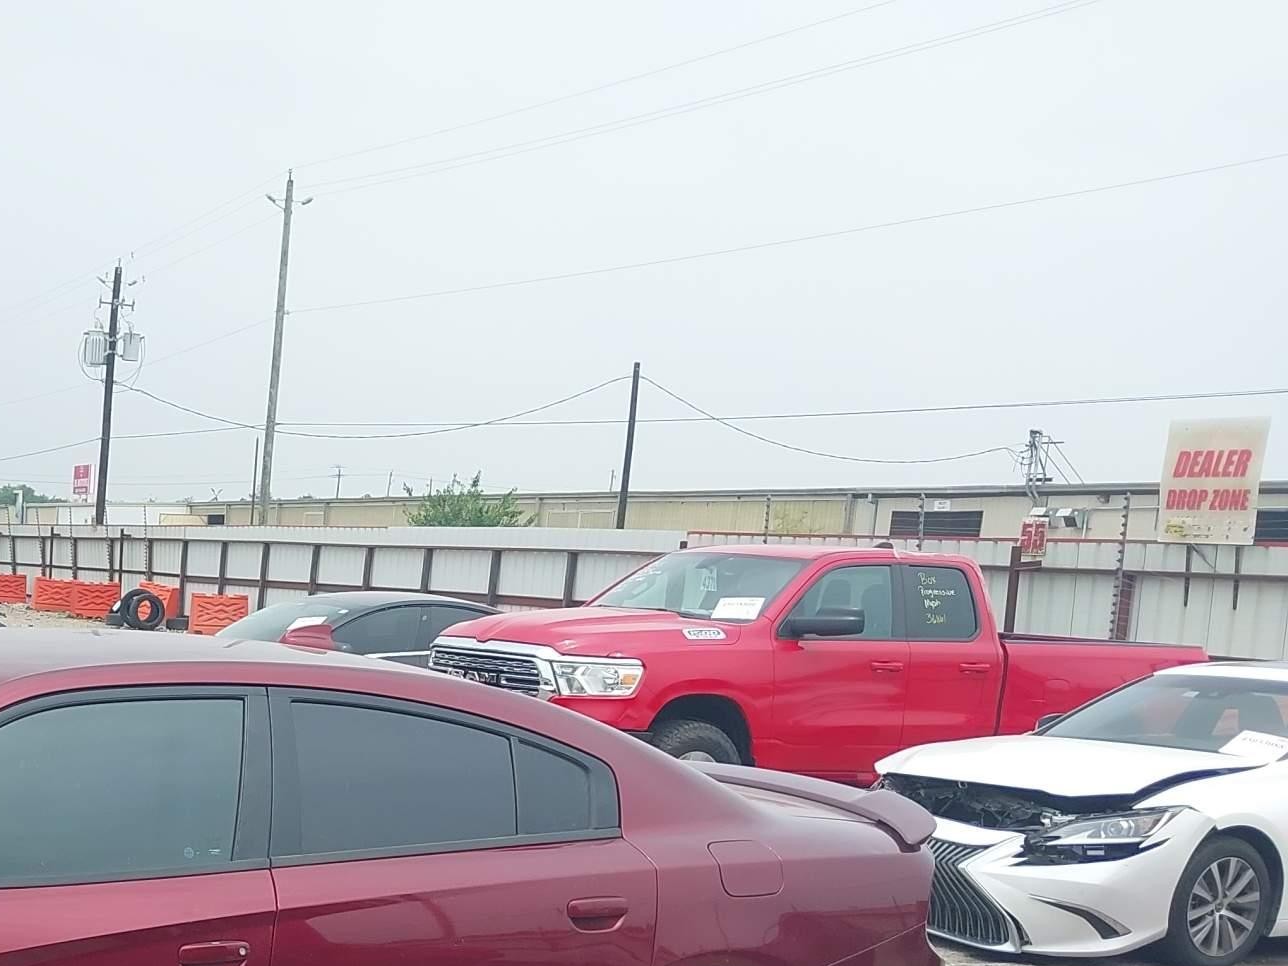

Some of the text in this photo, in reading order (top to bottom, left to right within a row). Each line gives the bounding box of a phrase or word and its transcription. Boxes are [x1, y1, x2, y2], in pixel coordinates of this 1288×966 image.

[1173, 449, 1252, 478] DEALER
[1166, 489, 1251, 511] DROP ZONE
[1021, 523, 1046, 551] 55
